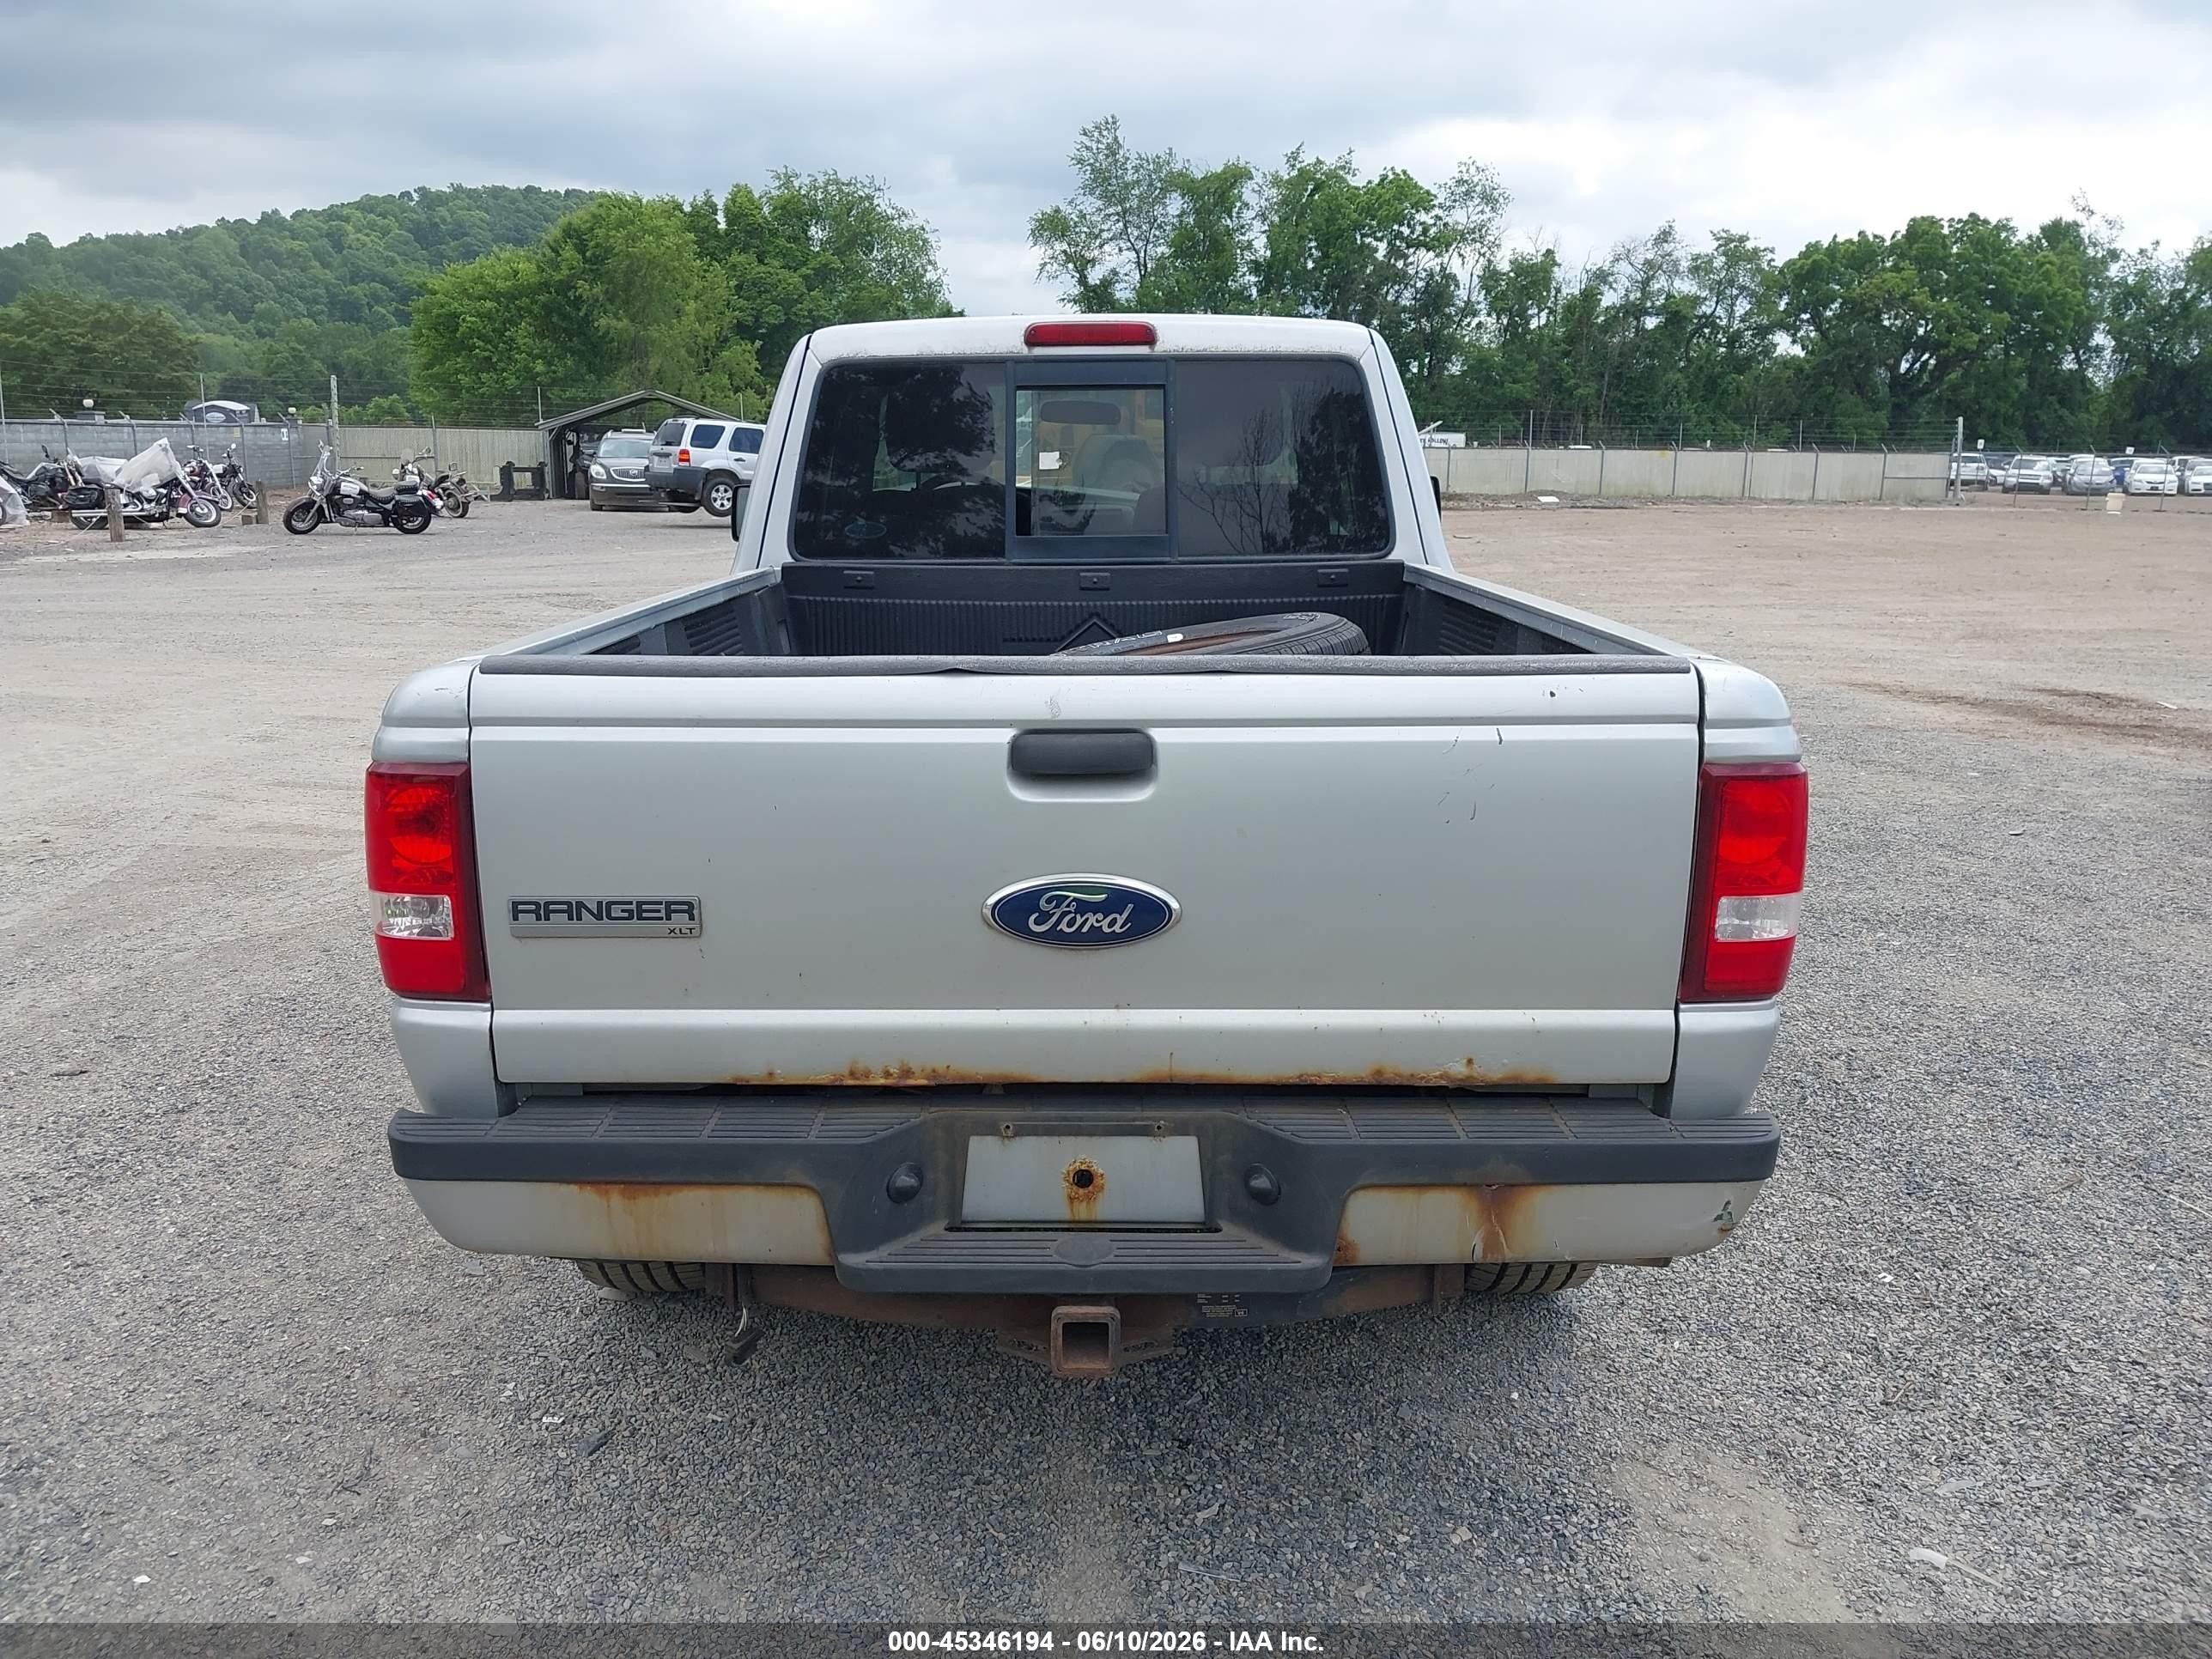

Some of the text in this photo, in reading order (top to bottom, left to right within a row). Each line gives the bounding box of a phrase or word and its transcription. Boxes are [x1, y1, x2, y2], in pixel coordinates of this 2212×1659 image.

[511, 900, 696, 921] RANGER
[1028, 890, 1134, 933] Ford
[667, 927, 696, 935] XLT
